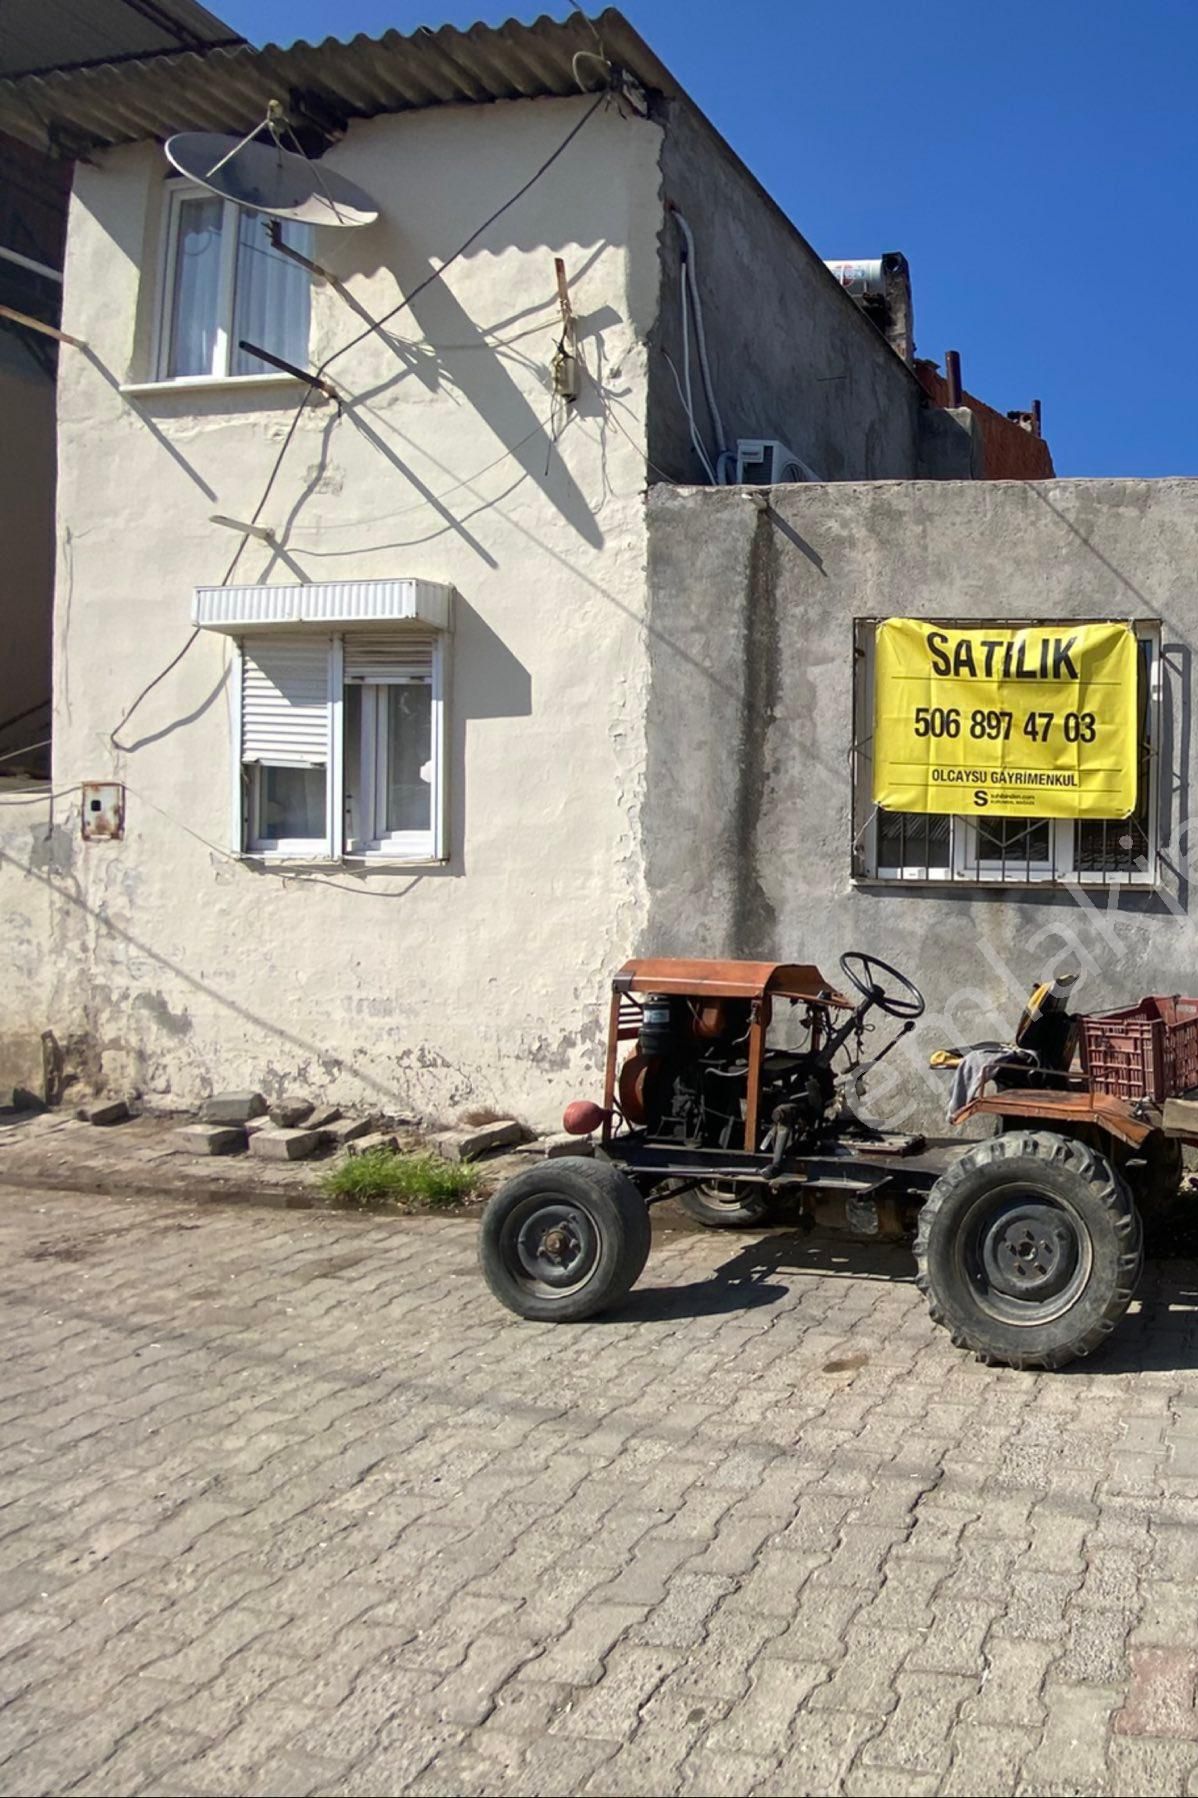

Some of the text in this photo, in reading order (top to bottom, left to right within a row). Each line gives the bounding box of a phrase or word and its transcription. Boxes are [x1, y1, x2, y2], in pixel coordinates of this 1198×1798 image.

[926, 631, 1079, 680] SATILIK
[914, 707, 1097, 743] 506 897 47 03
[931, 768, 1078, 787] OLCAYSU GAYRİMENKUL
[973, 789, 989, 807] S
